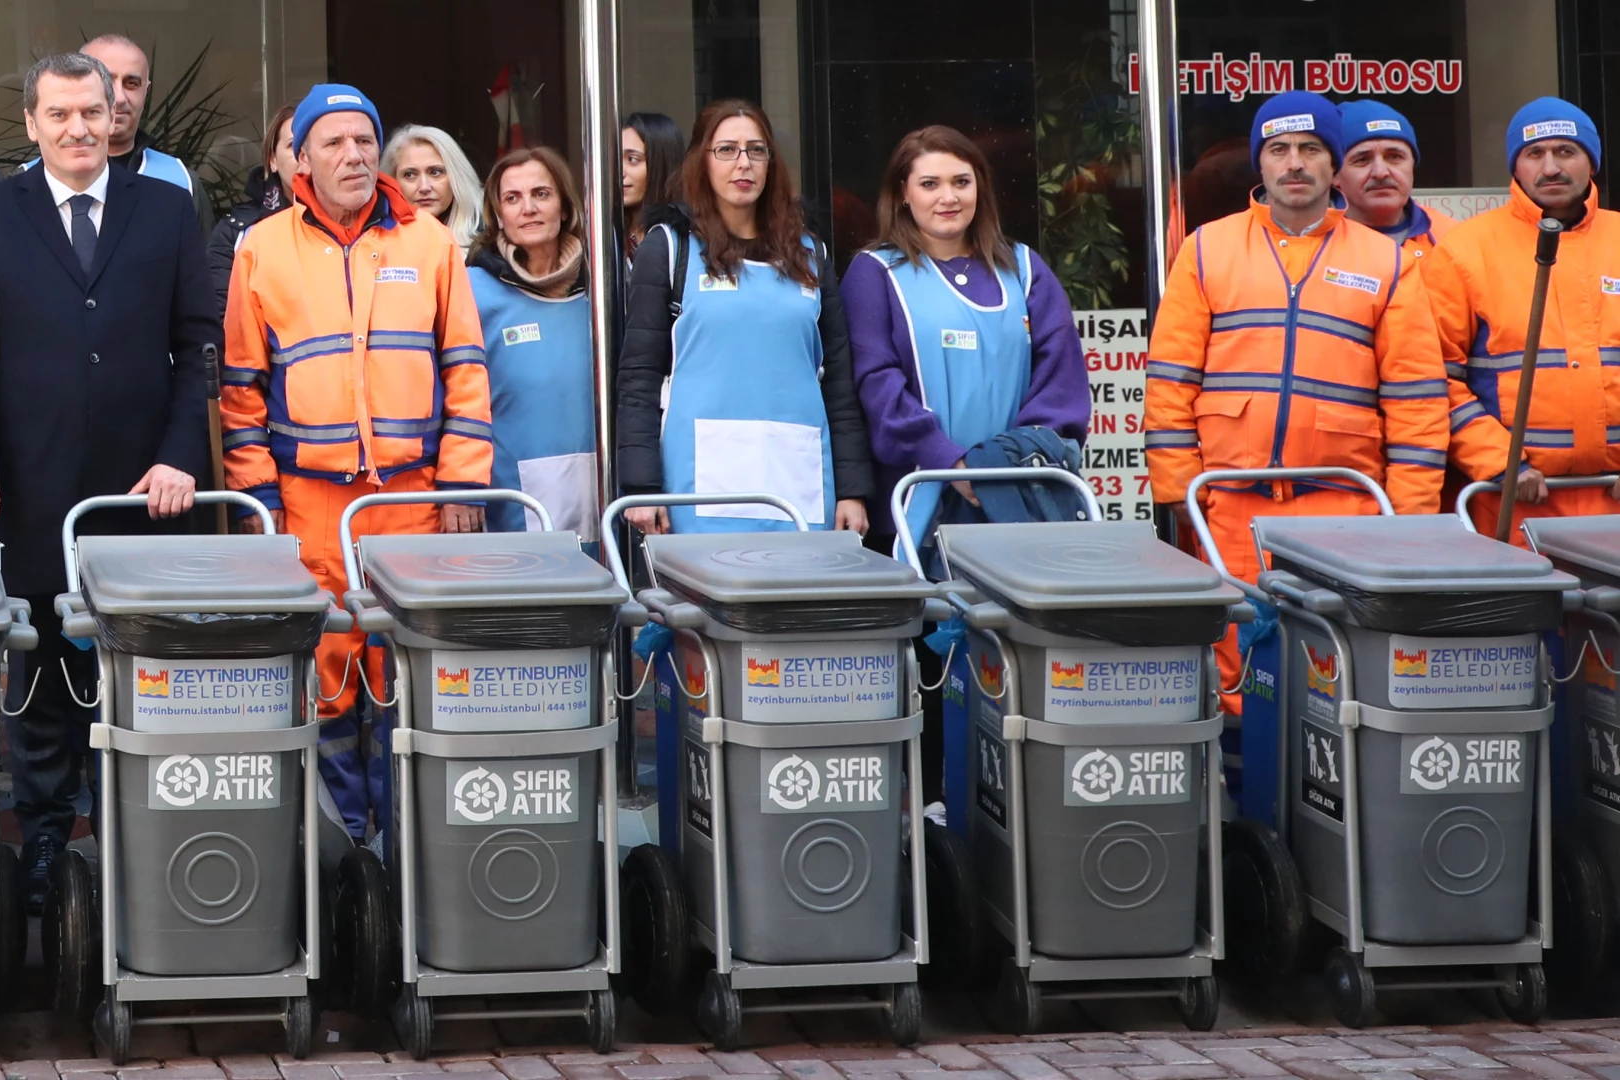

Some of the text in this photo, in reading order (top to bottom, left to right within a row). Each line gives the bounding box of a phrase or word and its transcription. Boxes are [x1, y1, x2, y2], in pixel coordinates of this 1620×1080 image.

[1305, 53, 1462, 95] BÜROSU
[1122, 387, 1144, 402] ve
[1087, 409, 1116, 434] İN
[1431, 644, 1537, 663] ZEYTİNBURNU
[784, 654, 895, 672] ZEYTİNBURNU
[1088, 659, 1198, 676] ZEYTİNBURNU
[1431, 662, 1533, 678] BELEDİYES
[173, 666, 289, 684] ZEYTİNBURNU
[473, 663, 587, 682] ZEYTİNBURNU
[784, 671, 895, 688] BELEDİYESİ
[1256, 669, 1275, 687] SIFIR
[173, 682, 289, 700] BELEDİYESİ
[474, 680, 587, 697] BELEDİYESİ
[1088, 675, 1198, 692] BELEDİYESİ
[1394, 684, 1494, 695] zeytinburnu.istanbul
[1499, 683, 1516, 692] 444
[438, 700, 587, 715] zeytinburnu.istanbul 444 1984
[748, 691, 894, 706] zeytinburnu.istanbul 444 1984
[1051, 694, 1197, 708] zeytinburnu.istanbul 444 1984
[138, 703, 288, 717] zeytinburnu.istanbul 444 1984
[1466, 740, 1521, 760] SIFIR
[215, 755, 273, 776] SIFIR
[826, 756, 882, 779] SIFIR
[1129, 750, 1185, 772] SIFIR
[513, 769, 571, 791] SIFIR
[1464, 762, 1521, 784] ATIK
[213, 776, 274, 801] ATIK
[824, 779, 883, 803] ATIK
[1128, 772, 1185, 796] ATIK
[511, 791, 572, 815] ATIK
